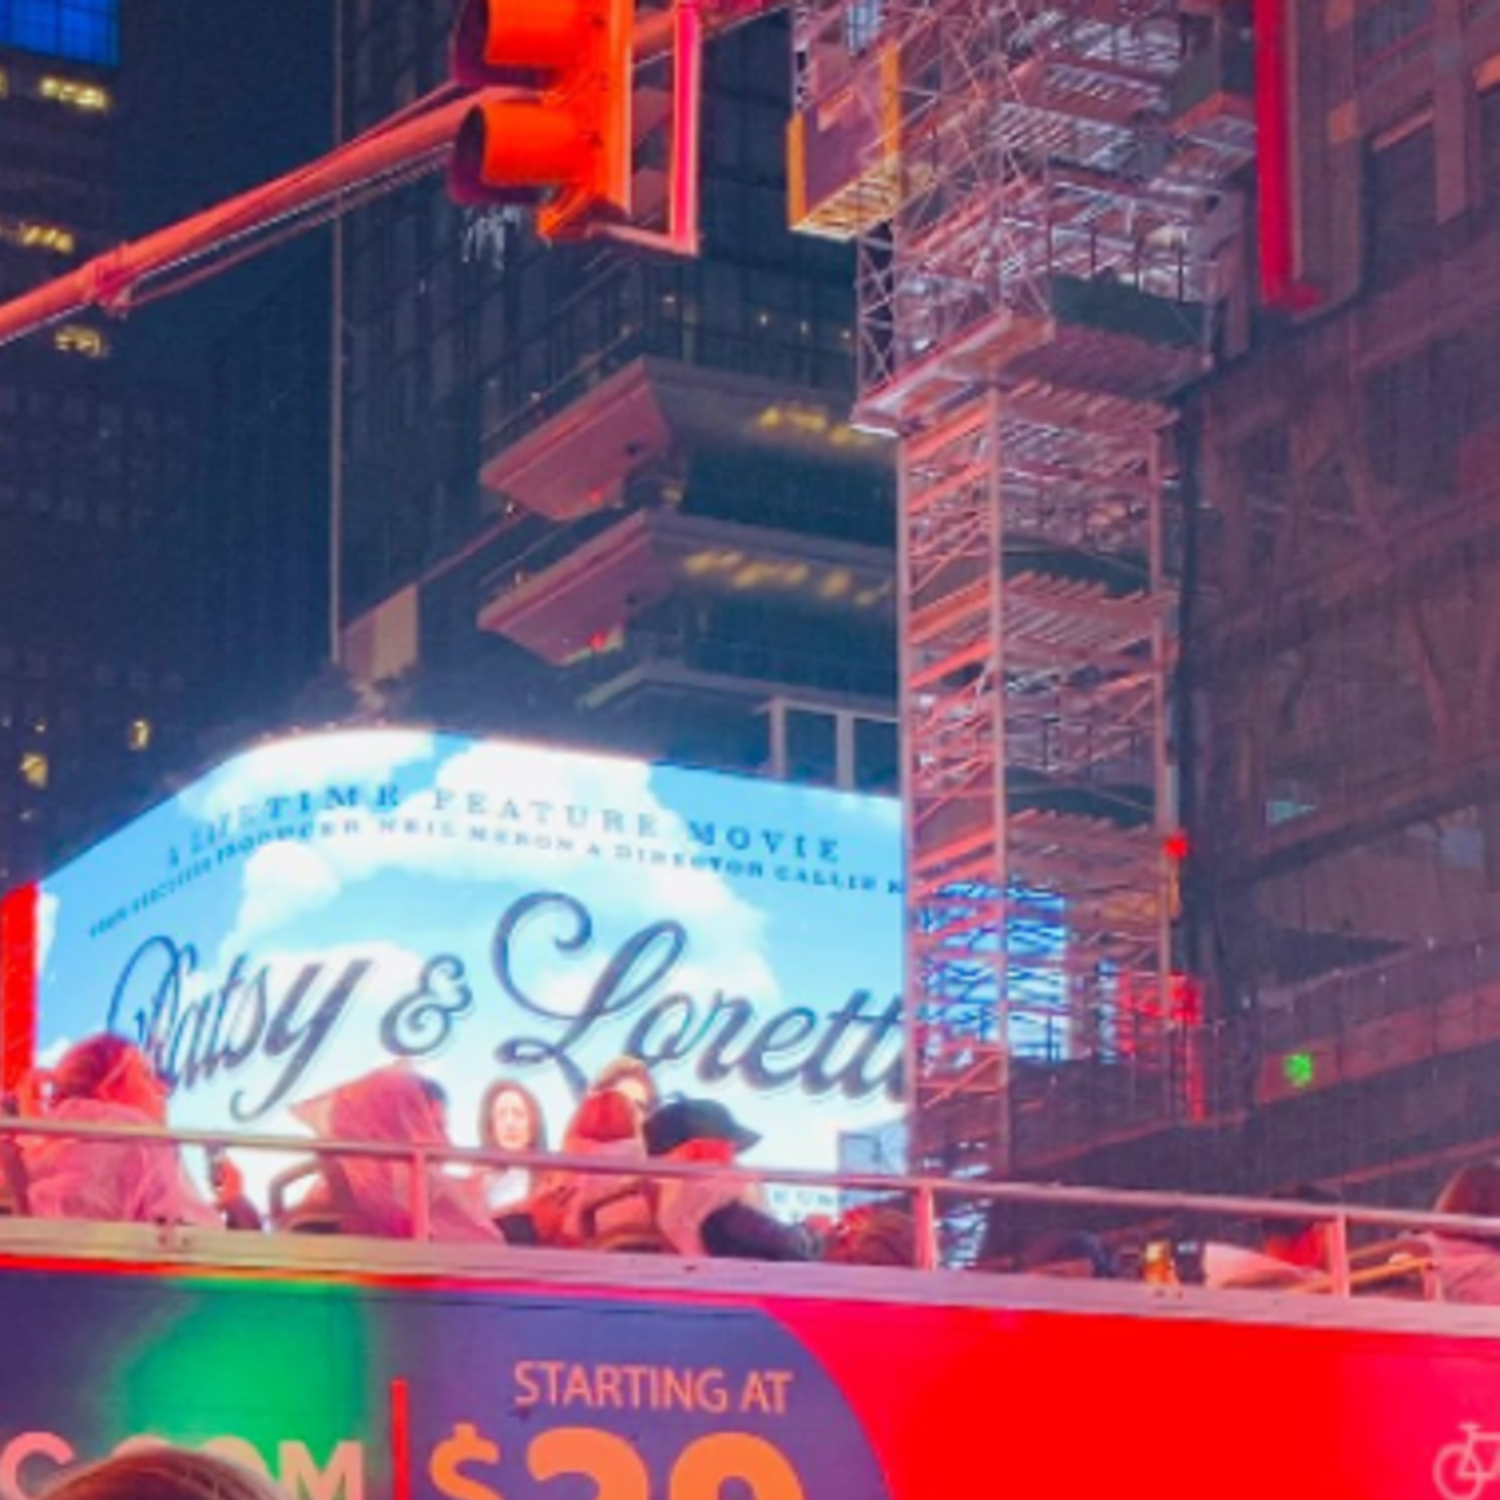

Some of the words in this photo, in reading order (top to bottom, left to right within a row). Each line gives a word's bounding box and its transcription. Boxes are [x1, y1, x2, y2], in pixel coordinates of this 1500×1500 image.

[433, 788, 658, 838] FEATURE
[687, 820, 841, 863] MOVIE
[105, 934, 372, 1124] Patsy
[380, 953, 473, 1057] &
[491, 891, 908, 1103] Lorett
[514, 1360, 730, 1412] STARTING
[740, 1370, 794, 1414] AT
